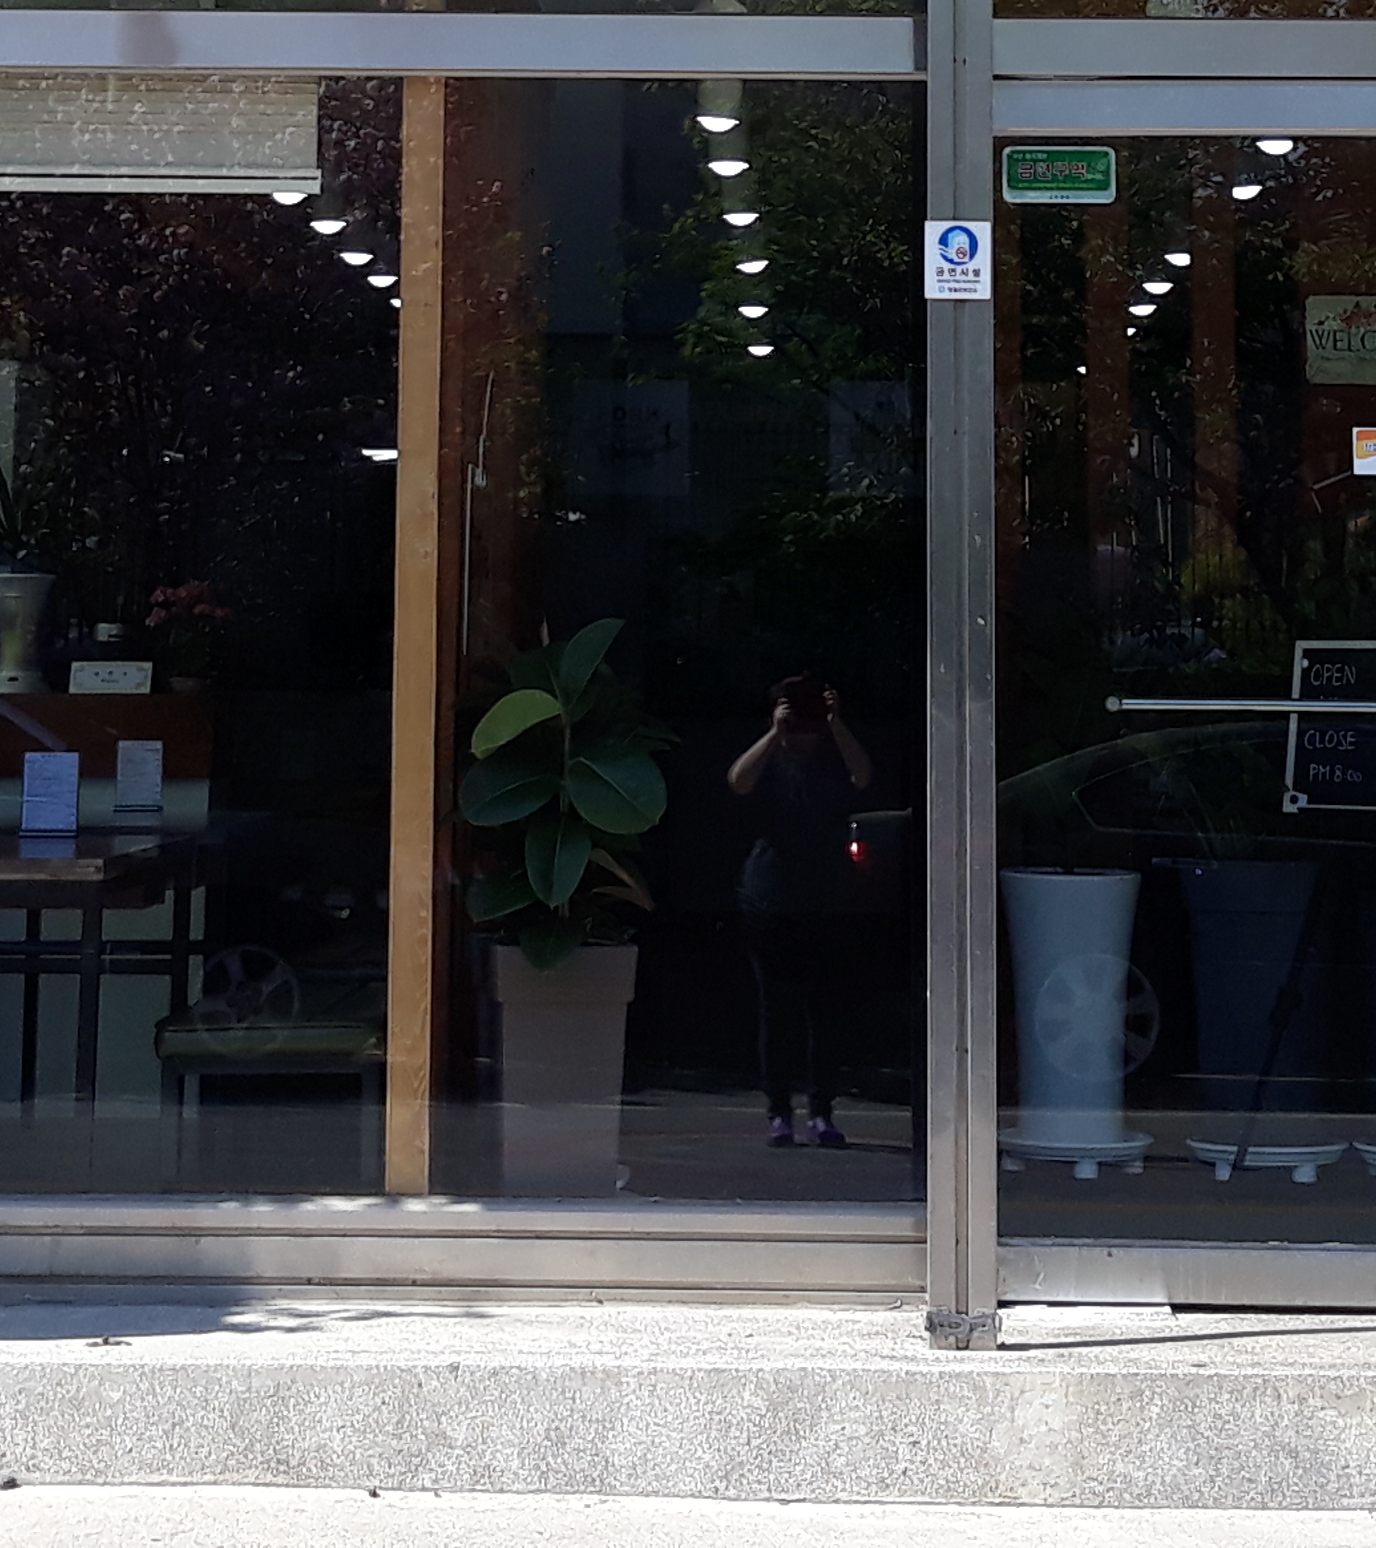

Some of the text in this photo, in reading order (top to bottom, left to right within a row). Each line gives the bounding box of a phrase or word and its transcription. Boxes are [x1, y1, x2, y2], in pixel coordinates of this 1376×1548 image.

[1018, 161, 1087, 180] 금연구역
[1310, 663, 1357, 686] OPEN
[1304, 730, 1357, 750] CLOSE
